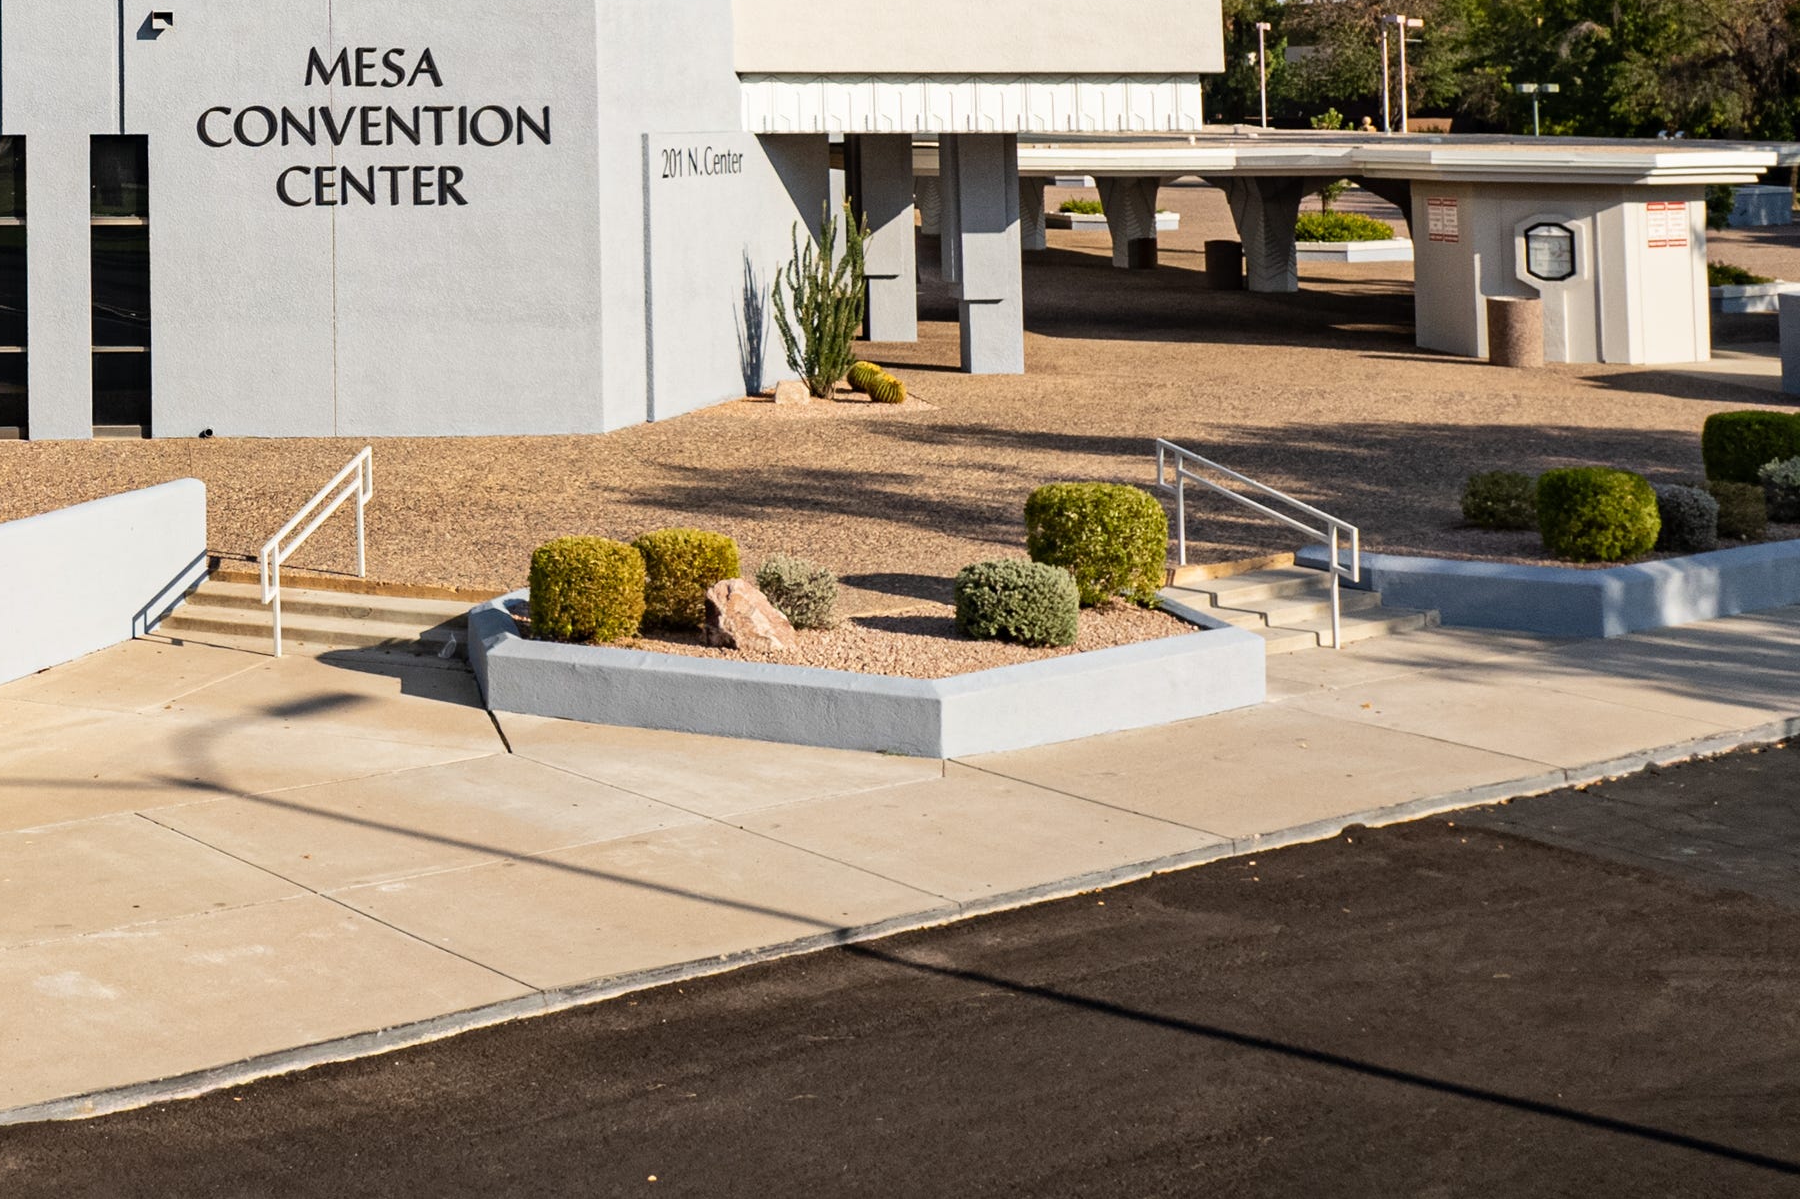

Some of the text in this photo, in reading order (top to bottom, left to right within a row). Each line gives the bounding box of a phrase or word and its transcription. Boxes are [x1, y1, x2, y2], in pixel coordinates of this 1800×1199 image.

[304, 46, 444, 88] MESA
[196, 105, 551, 148] CONVENTION
[661, 148, 683, 179] 201
[704, 146, 743, 176] Center
[276, 165, 469, 207] CENTER
